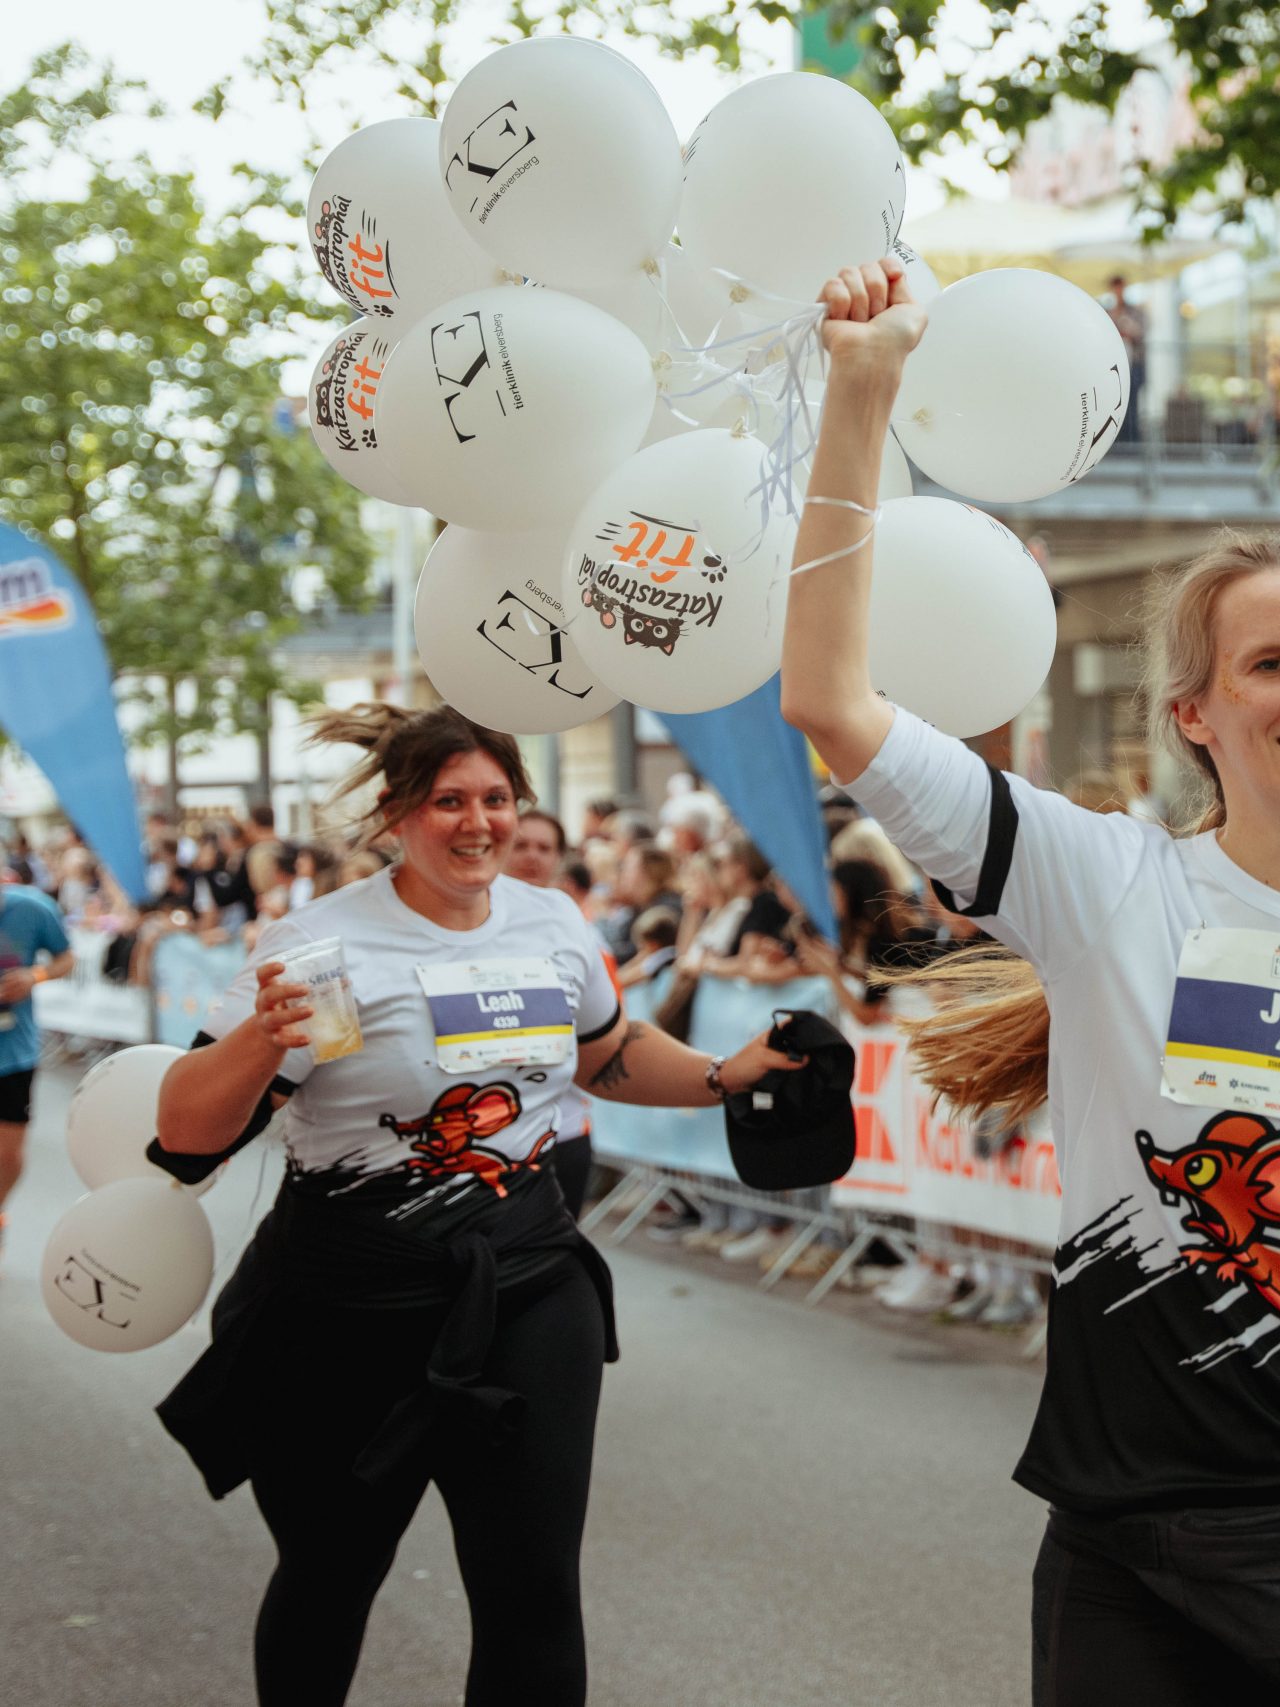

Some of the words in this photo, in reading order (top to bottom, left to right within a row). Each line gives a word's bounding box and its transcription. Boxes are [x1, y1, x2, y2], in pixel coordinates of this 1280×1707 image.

[478, 191, 501, 225] tierklinik
[499, 155, 540, 195] elversberg
[348, 233, 393, 298] fit
[493, 312, 510, 359] elversberg
[347, 356, 385, 421] fit
[501, 359, 524, 410] tierklinik
[612, 521, 696, 584] fit
[475, 990, 536, 1014] Leah
[1198, 1071, 1217, 1082] dm
